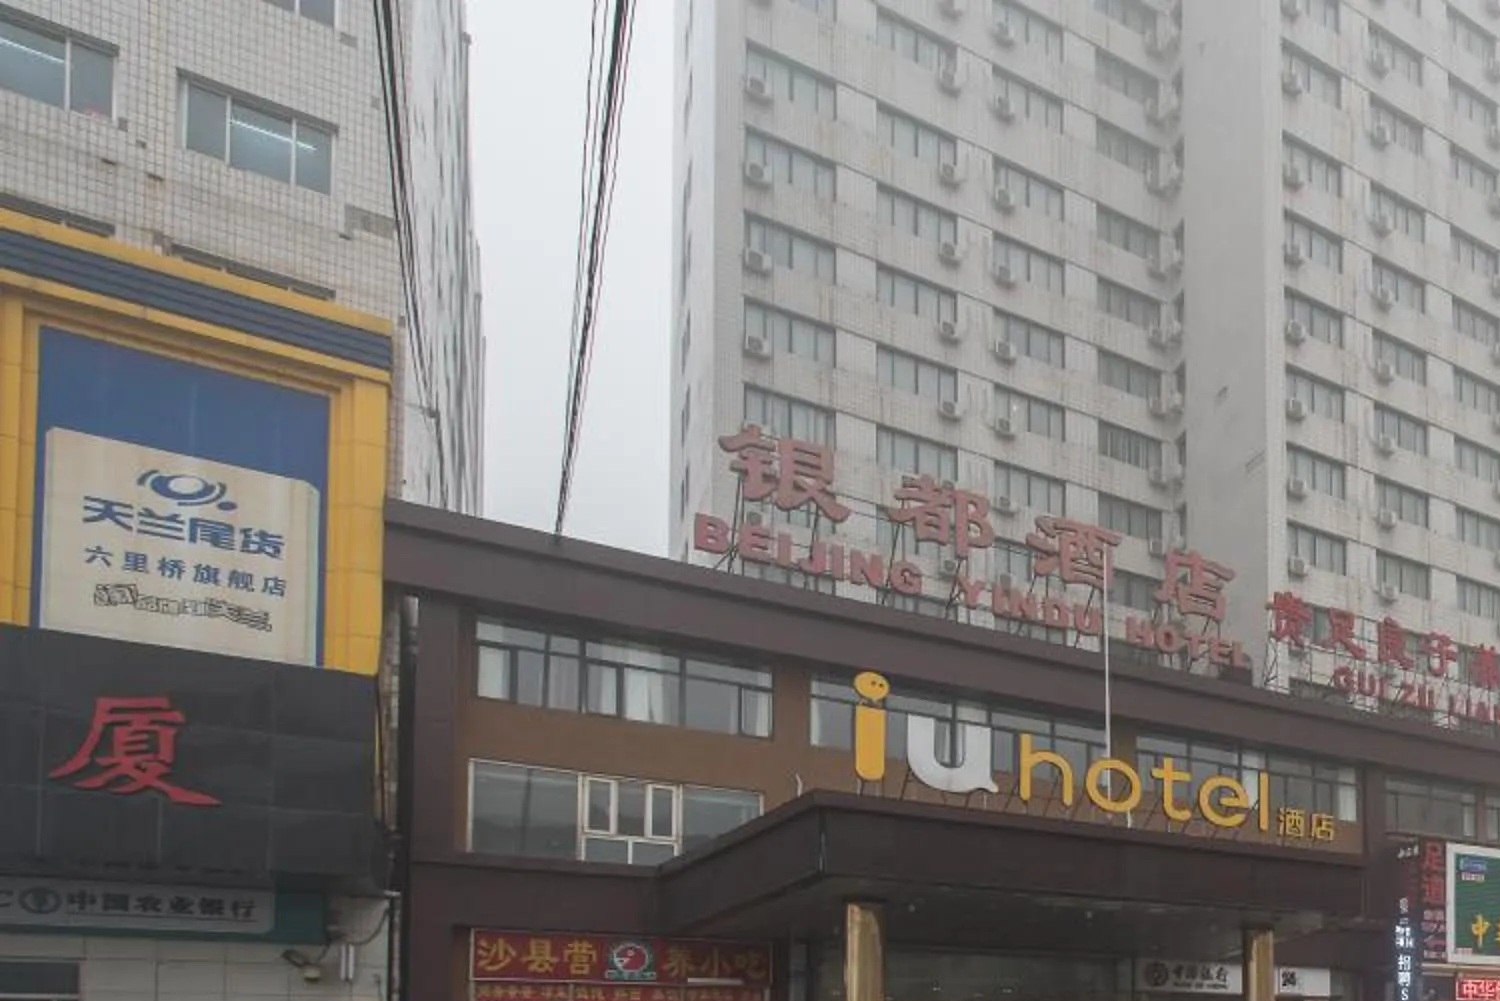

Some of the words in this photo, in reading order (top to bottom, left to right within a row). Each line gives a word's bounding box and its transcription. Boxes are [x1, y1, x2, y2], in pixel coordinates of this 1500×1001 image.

[82, 494, 285, 562] 天兰尾货
[718, 426, 1236, 621] 银都酒店
[85, 544, 288, 597] 六里桥旗舰店
[694, 512, 924, 597] BEIJING
[955, 573, 1104, 637] YINDU
[1124, 615, 1252, 670] HOTEL
[1332, 666, 1388, 699] GUI
[1398, 682, 1435, 711] ZU
[48, 695, 221, 807] 厦
[1019, 734, 1269, 830] hotel
[1276, 806, 1335, 841] 酒店
[66, 889, 257, 918] 中国农业银行
[477, 938, 597, 975] 沙县营
[663, 945, 766, 979] 养小吃
